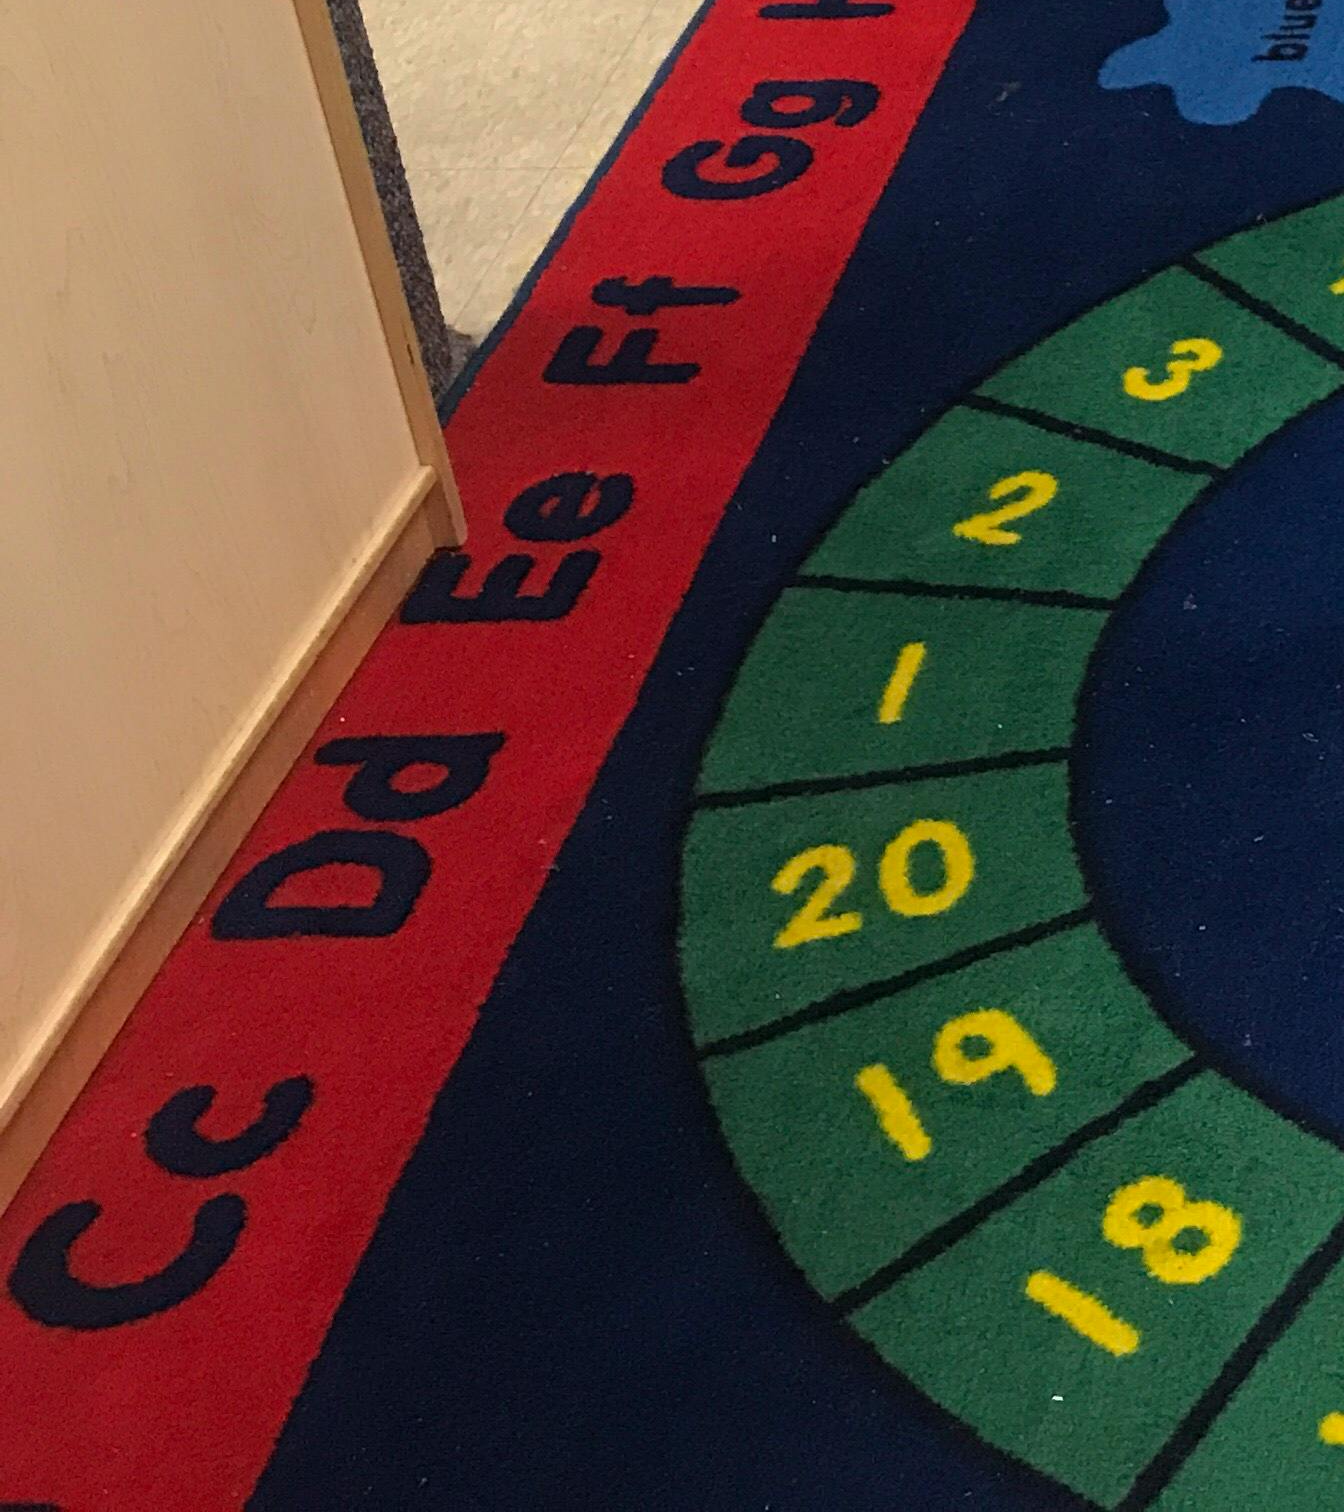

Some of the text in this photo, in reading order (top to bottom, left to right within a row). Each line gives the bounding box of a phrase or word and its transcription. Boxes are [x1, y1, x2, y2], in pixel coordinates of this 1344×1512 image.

[1124, 338, 1222, 401] 3
[953, 471, 1057, 545] 2
[6, 1074, 315, 1330] Cc
[211, 731, 506, 939] Dd
[401, 472, 635, 624] Ee
[542, 276, 740, 384] Ff
[662, 78, 881, 201] Gg
[879, 643, 926, 723] 1
[772, 819, 974, 948] 20
[857, 1009, 1057, 1161] 19
[1027, 1176, 1241, 1356] 18
